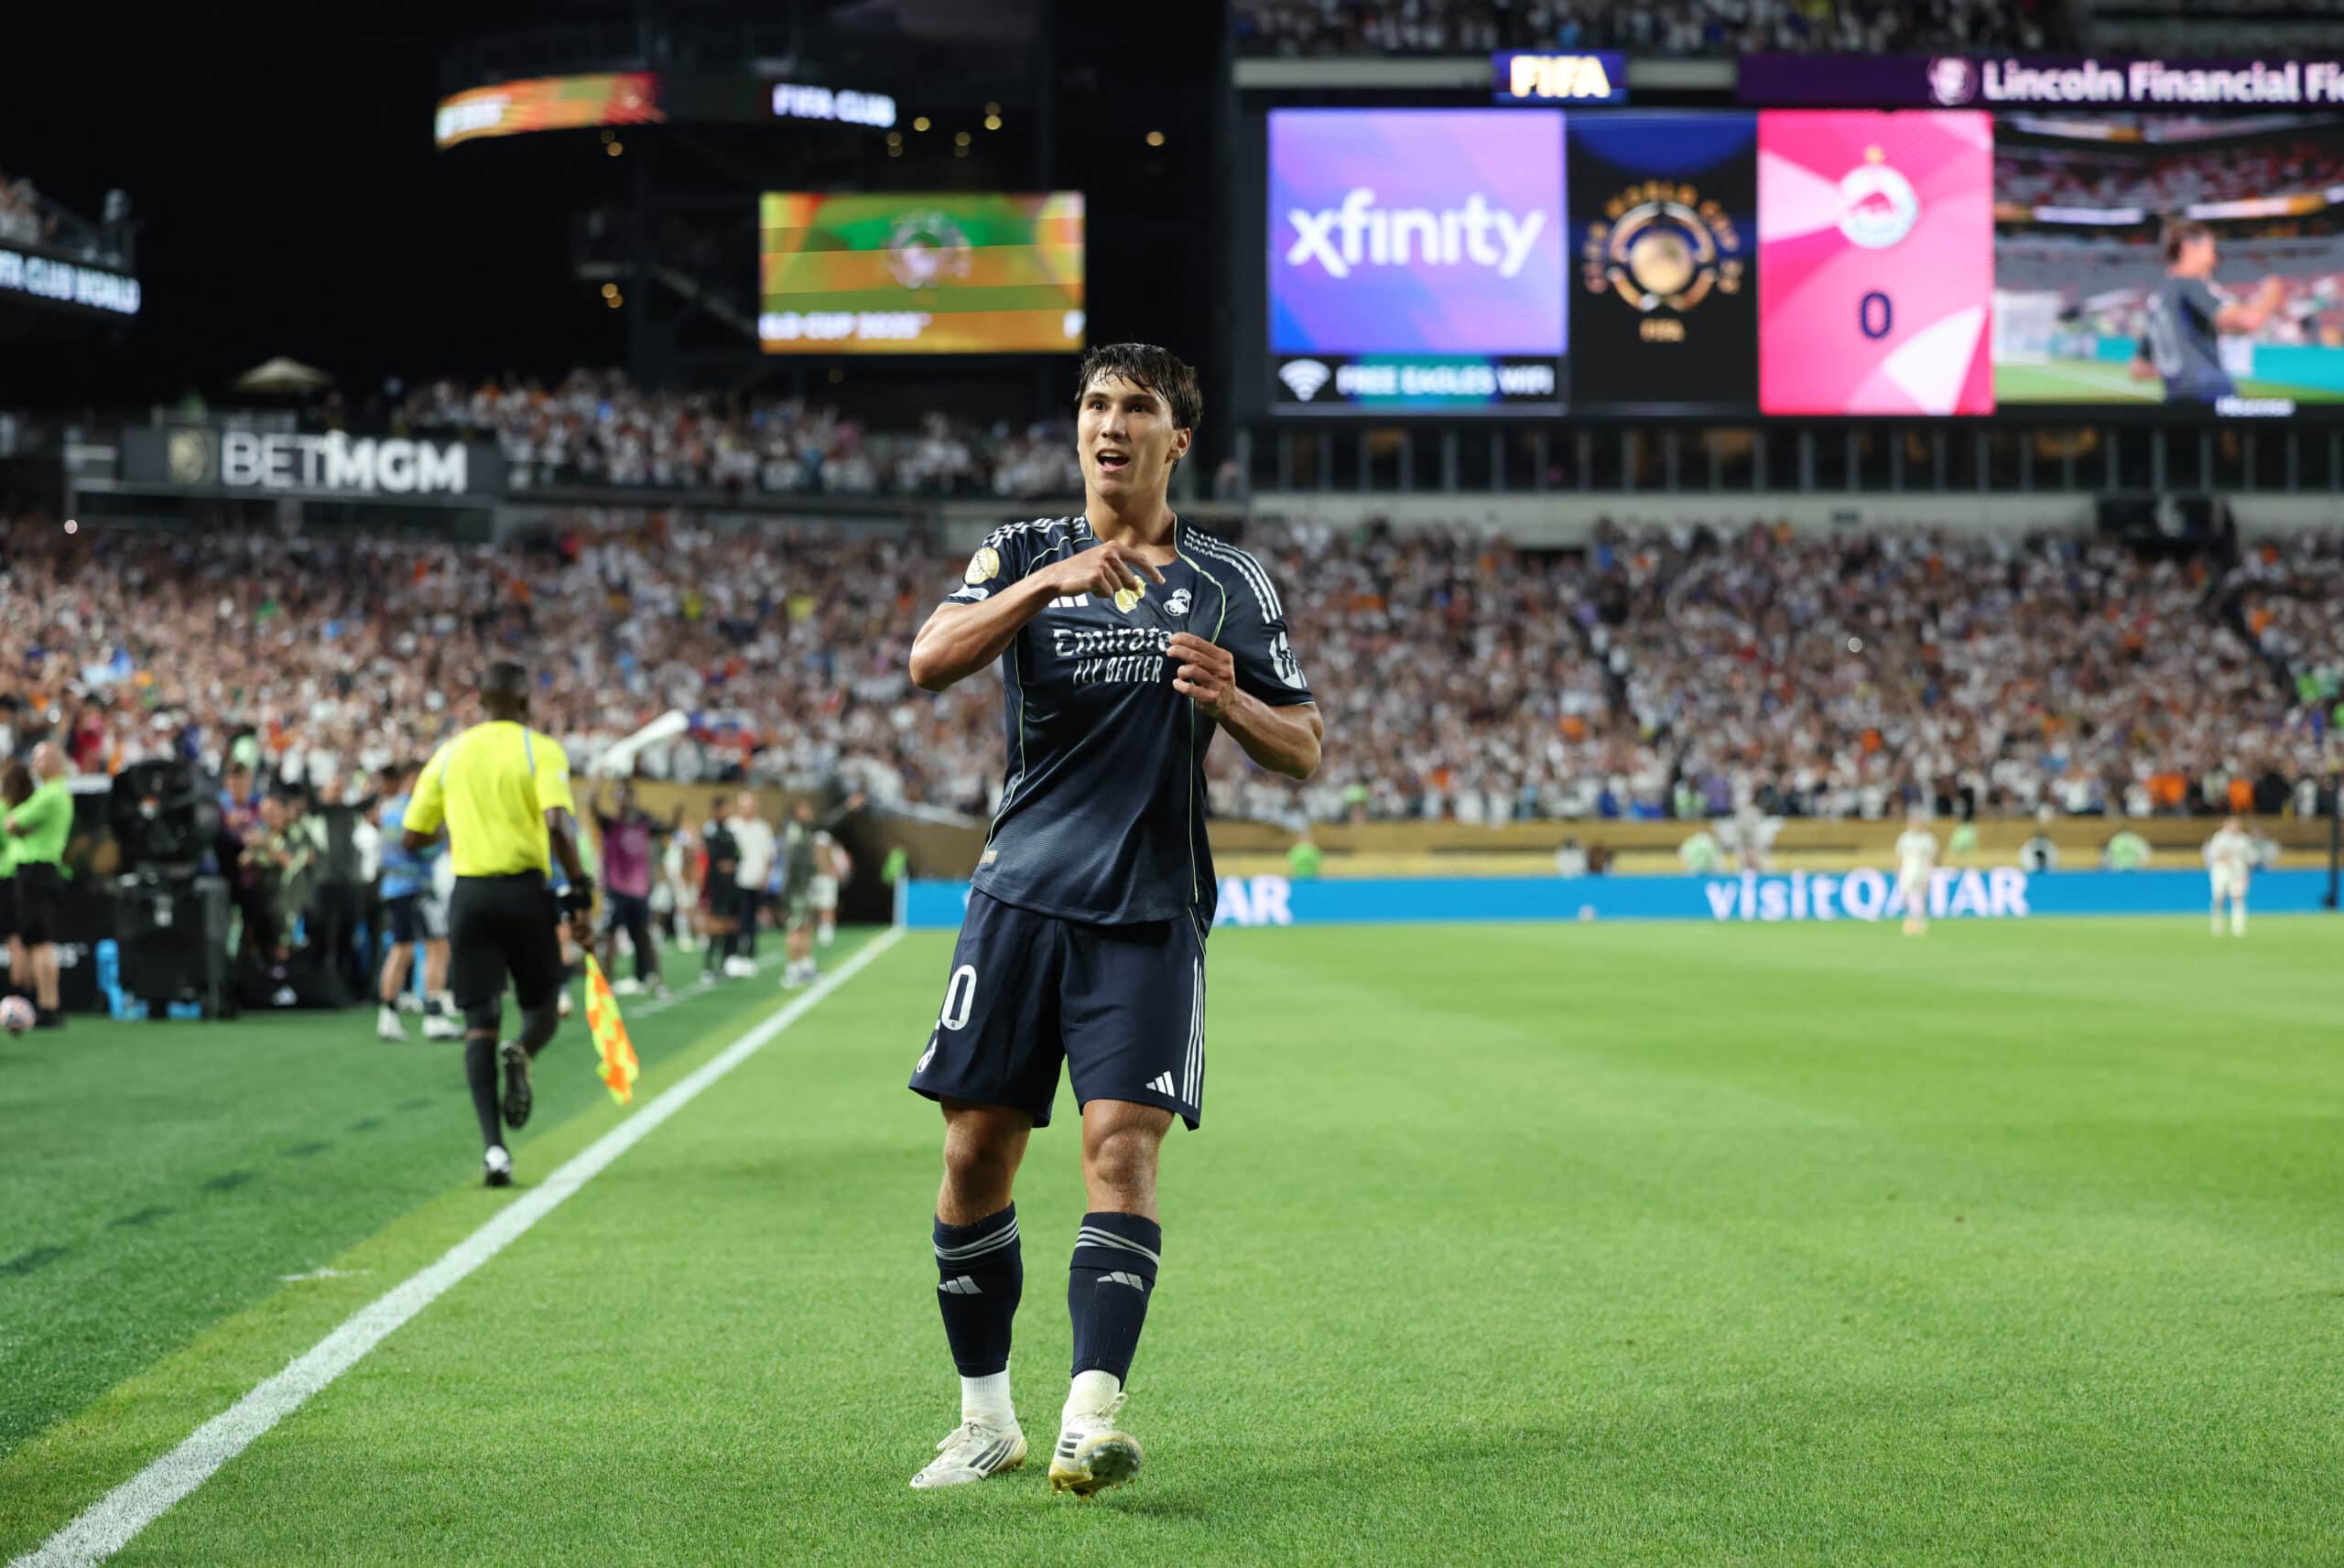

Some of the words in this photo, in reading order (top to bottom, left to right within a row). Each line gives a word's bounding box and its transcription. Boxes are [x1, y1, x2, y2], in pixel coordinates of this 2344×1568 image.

[1511, 56, 1611, 97] FIFA
[1983, 59, 2124, 101] Lincoln
[2130, 59, 2300, 102] Financial
[1287, 188, 1545, 277] xfinity
[1861, 291, 1894, 339] 0
[1401, 365, 1496, 395] EAGLES
[1053, 623, 1173, 657] Emirate
[1073, 658, 1102, 685] FLY
[1104, 655, 1164, 683] BETTER
[935, 965, 977, 1031] 0
